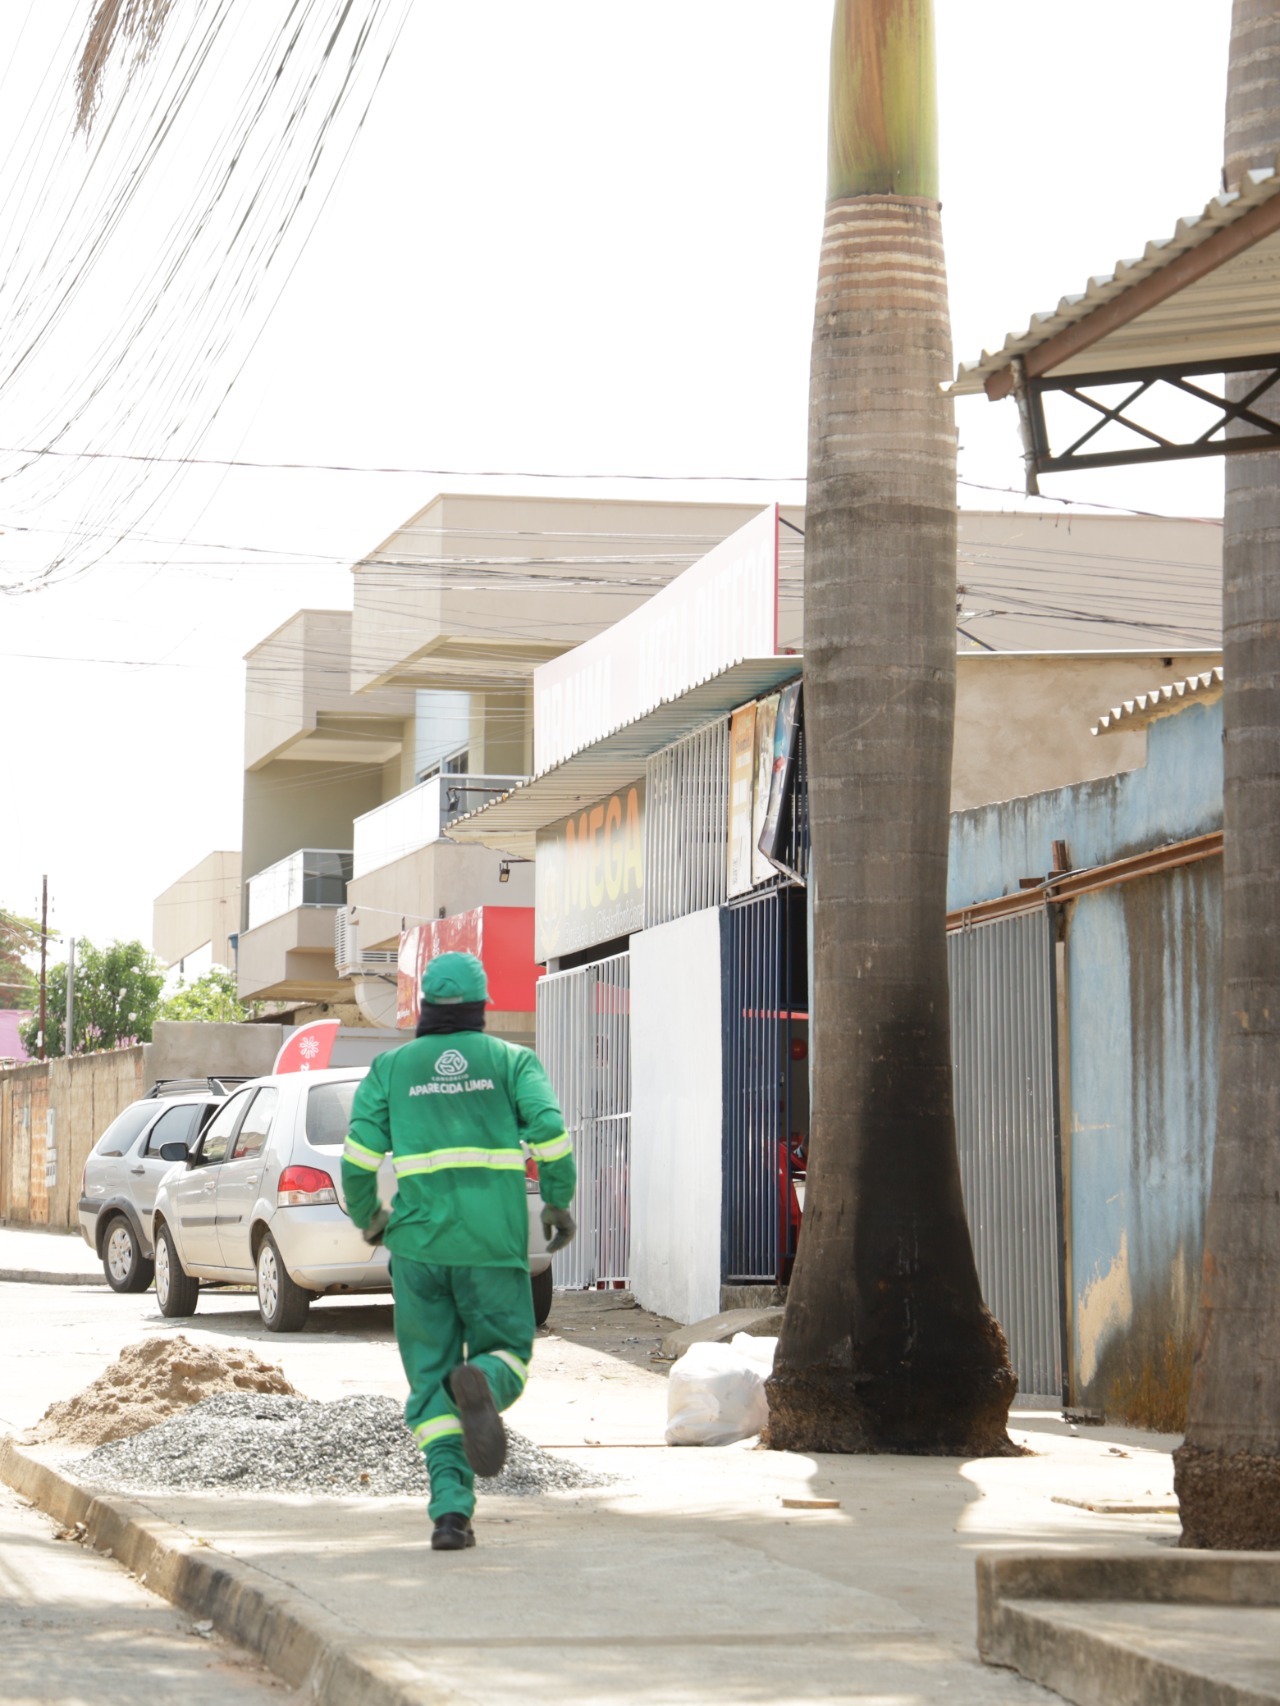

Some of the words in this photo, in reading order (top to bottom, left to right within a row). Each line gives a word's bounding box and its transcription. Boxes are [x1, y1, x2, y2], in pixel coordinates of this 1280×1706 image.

[564, 787, 644, 916] MEGA
[408, 1082, 464, 1097] APARECIDA
[464, 1079, 495, 1092] LIMPA
